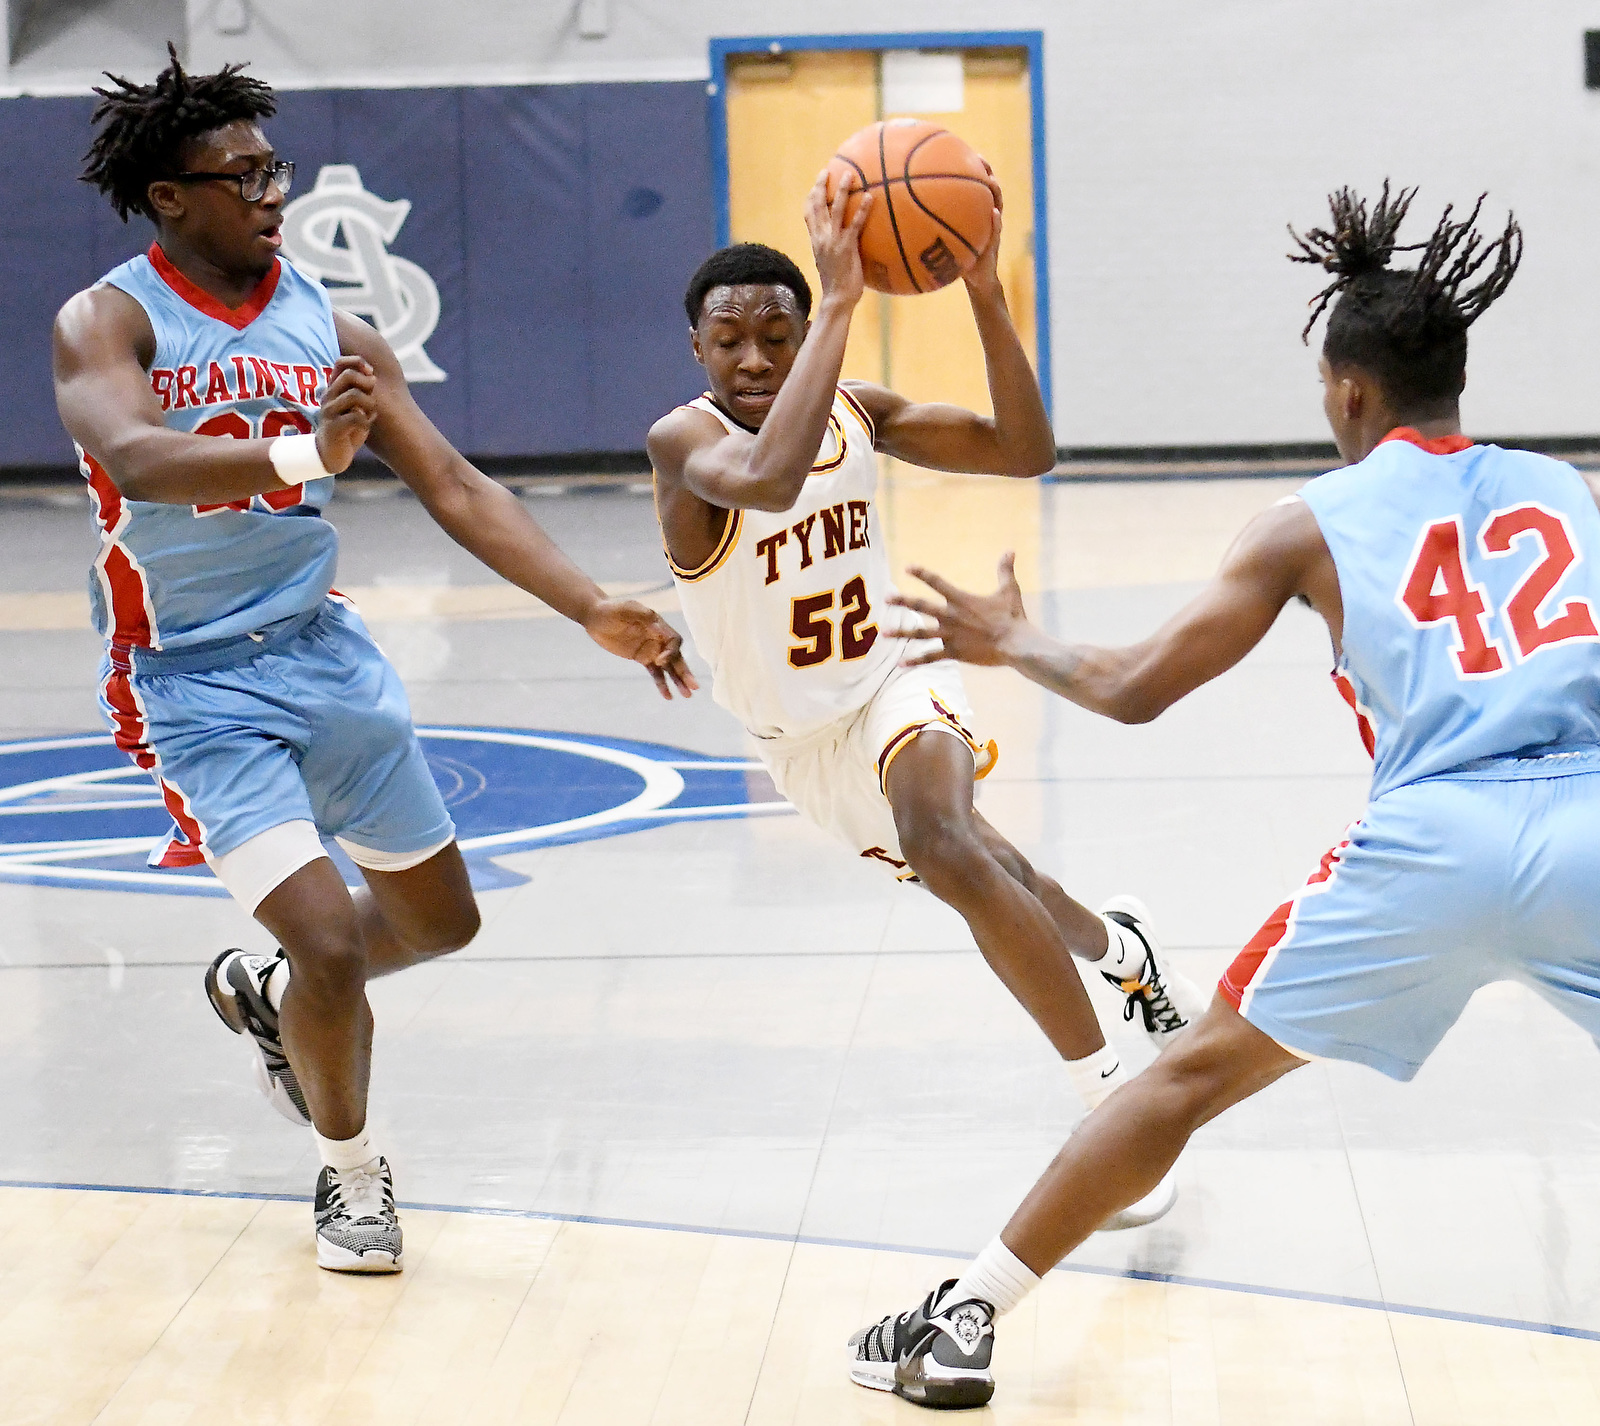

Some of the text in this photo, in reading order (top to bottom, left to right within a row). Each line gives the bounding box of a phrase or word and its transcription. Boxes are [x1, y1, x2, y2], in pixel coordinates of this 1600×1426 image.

[150, 355, 334, 411] BRAINER
[756, 499, 871, 587] TYNE
[787, 573, 880, 670] 52
[1394, 501, 1600, 681] 42
